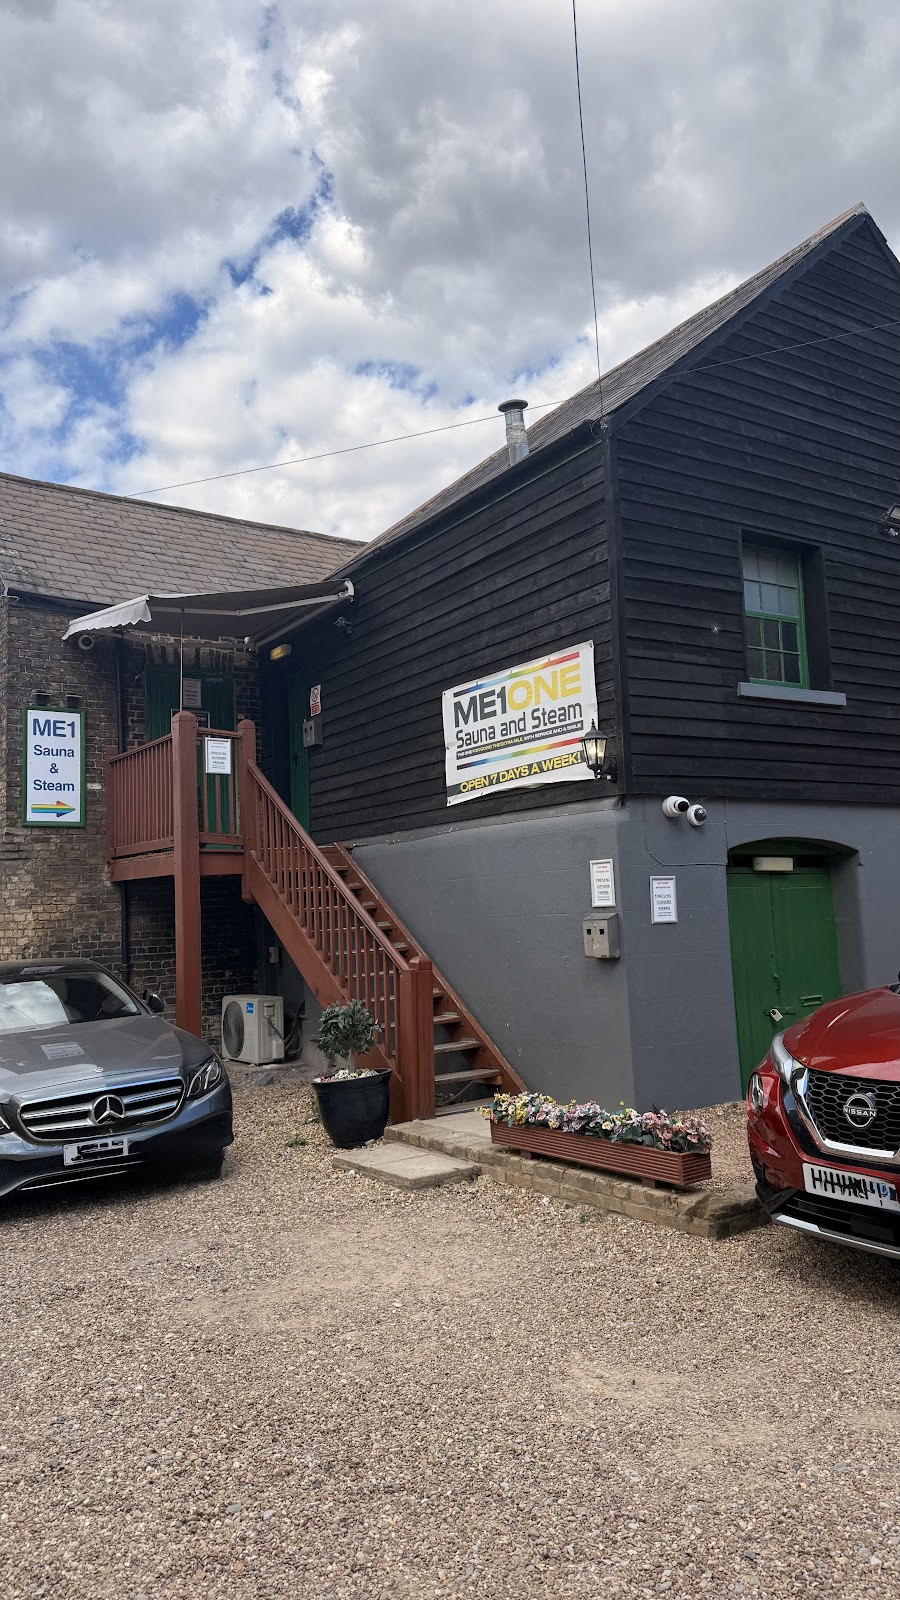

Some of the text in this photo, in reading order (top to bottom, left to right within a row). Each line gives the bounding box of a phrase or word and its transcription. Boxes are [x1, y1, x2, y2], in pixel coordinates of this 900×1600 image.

[32, 718, 76, 738] ME1
[456, 702, 583, 749] Sauna and Steam
[33, 744, 75, 758] Sauna
[49, 762, 59, 774] &
[459, 751, 582, 793] OPEN 7 DAYS A WEEK!
[33, 779, 75, 792] Steam
[843, 1106, 876, 1118] NISSAN
